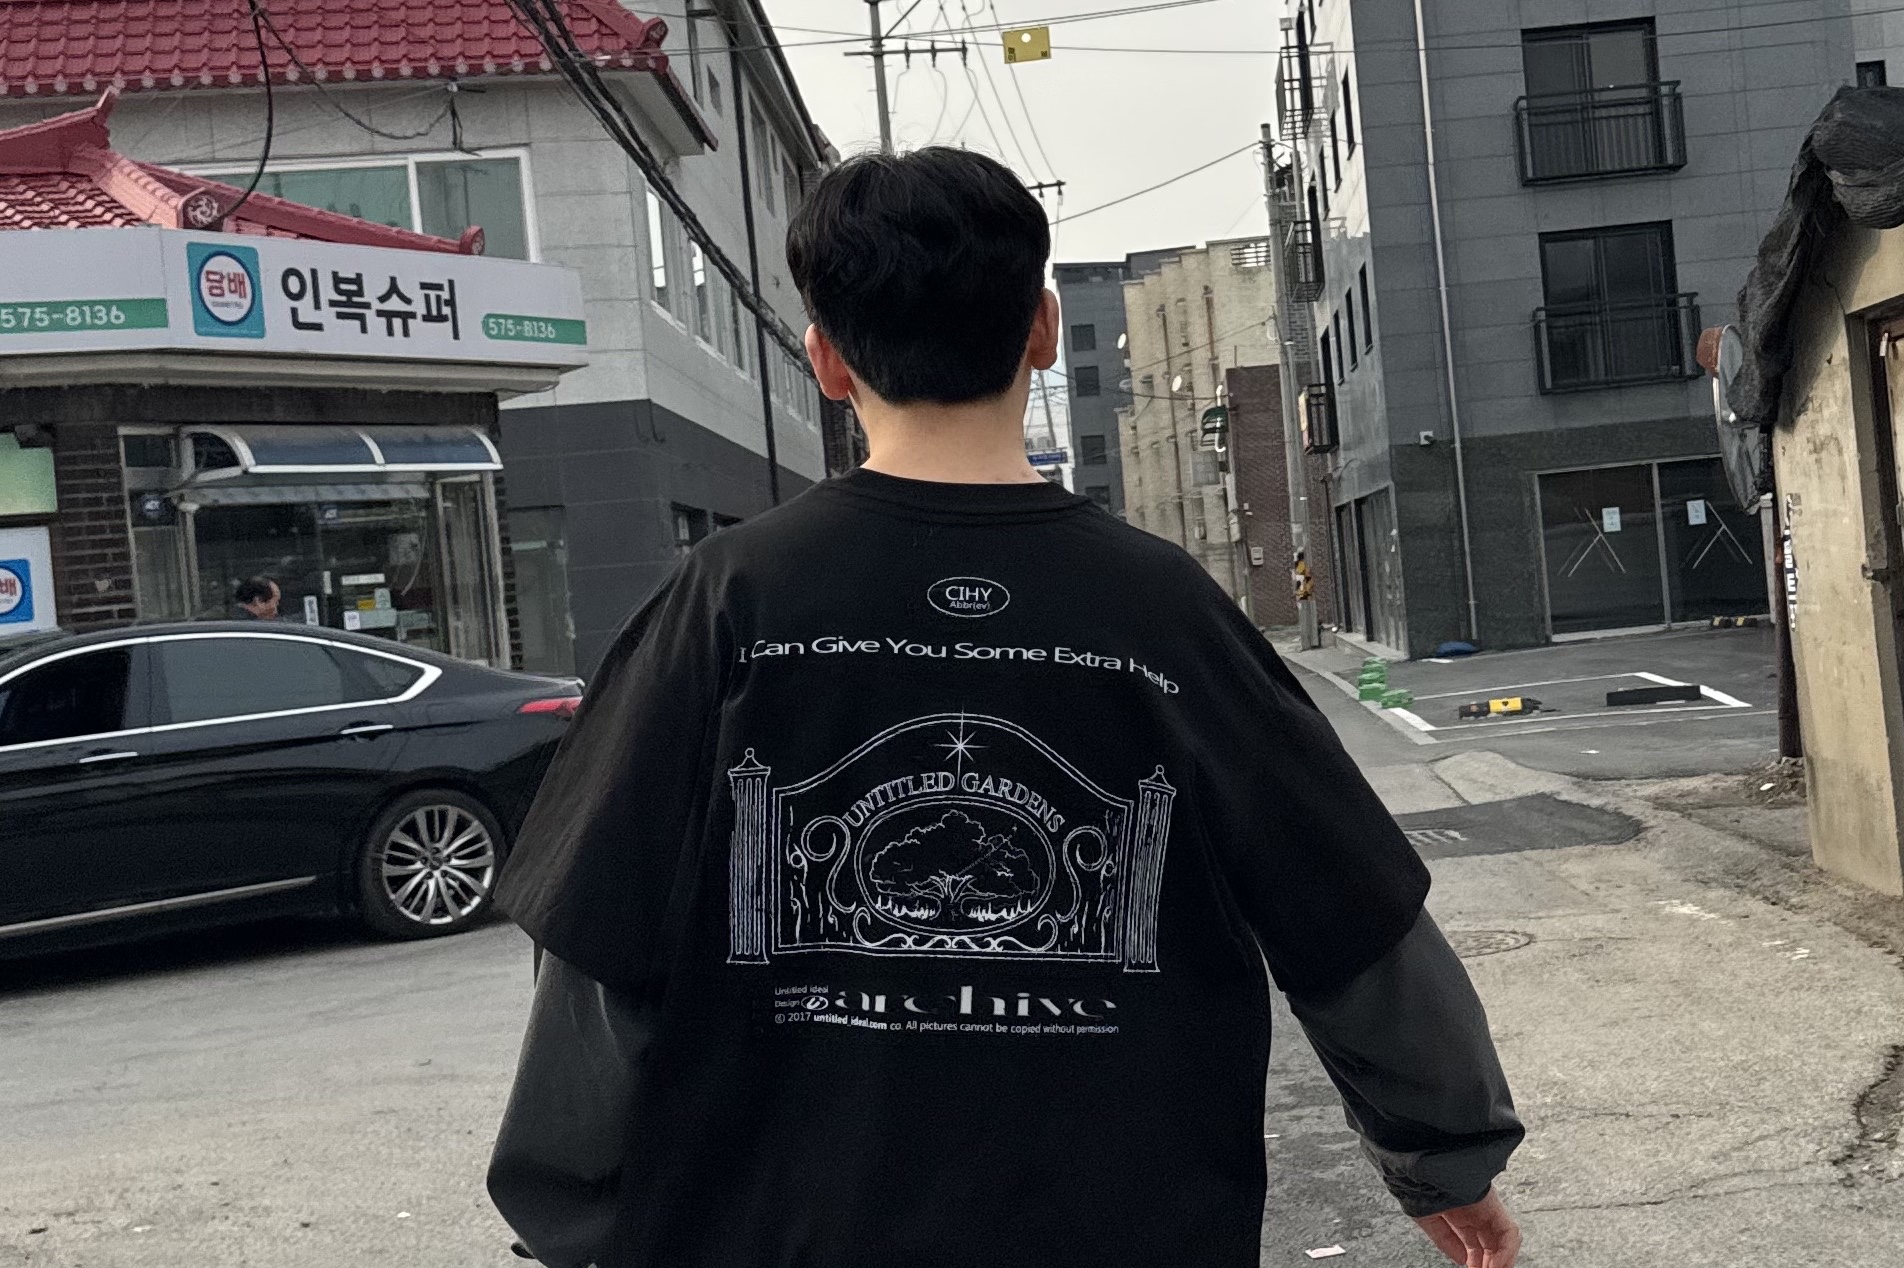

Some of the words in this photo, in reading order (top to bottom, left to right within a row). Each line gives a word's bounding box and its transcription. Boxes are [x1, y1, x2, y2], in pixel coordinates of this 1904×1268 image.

[205, 269, 247, 298] 담배
[0, 304, 126, 329] 575-8136
[281, 267, 460, 341] 인복슈퍼
[488, 317, 557, 340] 575-8136
[945, 585, 993, 602] CIHY
[751, 639, 805, 659] Can
[811, 635, 881, 654] Give
[885, 637, 947, 658] You
[953, 642, 1048, 662] Some
[1053, 646, 1122, 671] Extra
[1128, 657, 1180, 694] Help
[842, 771, 956, 827] UNTITLED
[960, 772, 1066, 834] GARDENS
[787, 1011, 812, 1022] 2017
[919, 1020, 958, 1033] pictures
[959, 1023, 994, 1032] cannot
[995, 1022, 1009, 1033] be
[1010, 1024, 1041, 1036] copied
[1042, 1024, 1075, 1034] without
